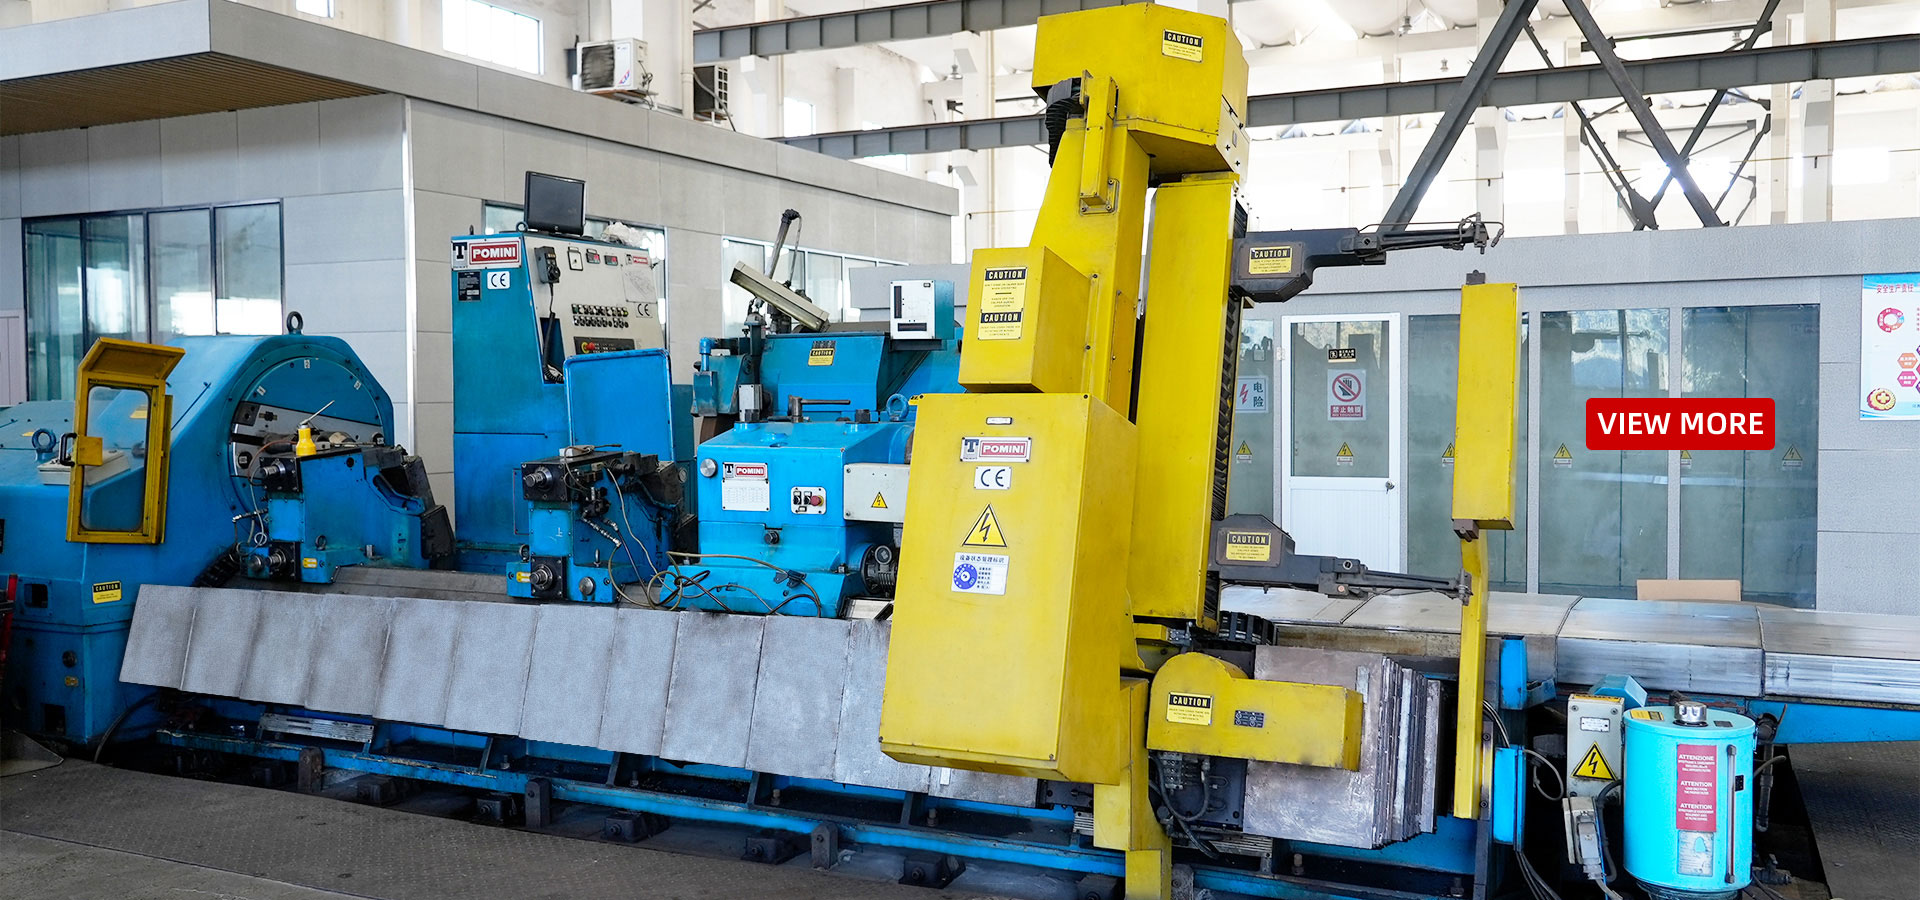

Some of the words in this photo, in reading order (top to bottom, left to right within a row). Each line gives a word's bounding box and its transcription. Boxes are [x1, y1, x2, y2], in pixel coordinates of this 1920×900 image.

[1167, 32, 1199, 46] CAUTION
[472, 247, 516, 259] POMINI
[1254, 250, 1288, 258] CAUTION
[490, 273, 506, 287] CE
[988, 270, 1023, 280] CAUTION
[1876, 284, 1914, 294] 安全生产责任
[637, 303, 650, 316] CE
[984, 313, 1019, 322] CAUTION
[983, 445, 1024, 453] POMINI
[736, 466, 764, 474] POMINI
[980, 468, 1005, 487] CE
[1231, 535, 1266, 544] CAUTION
[95, 583, 118, 591] CAUTION
[1172, 696, 1208, 707] CAUTION
